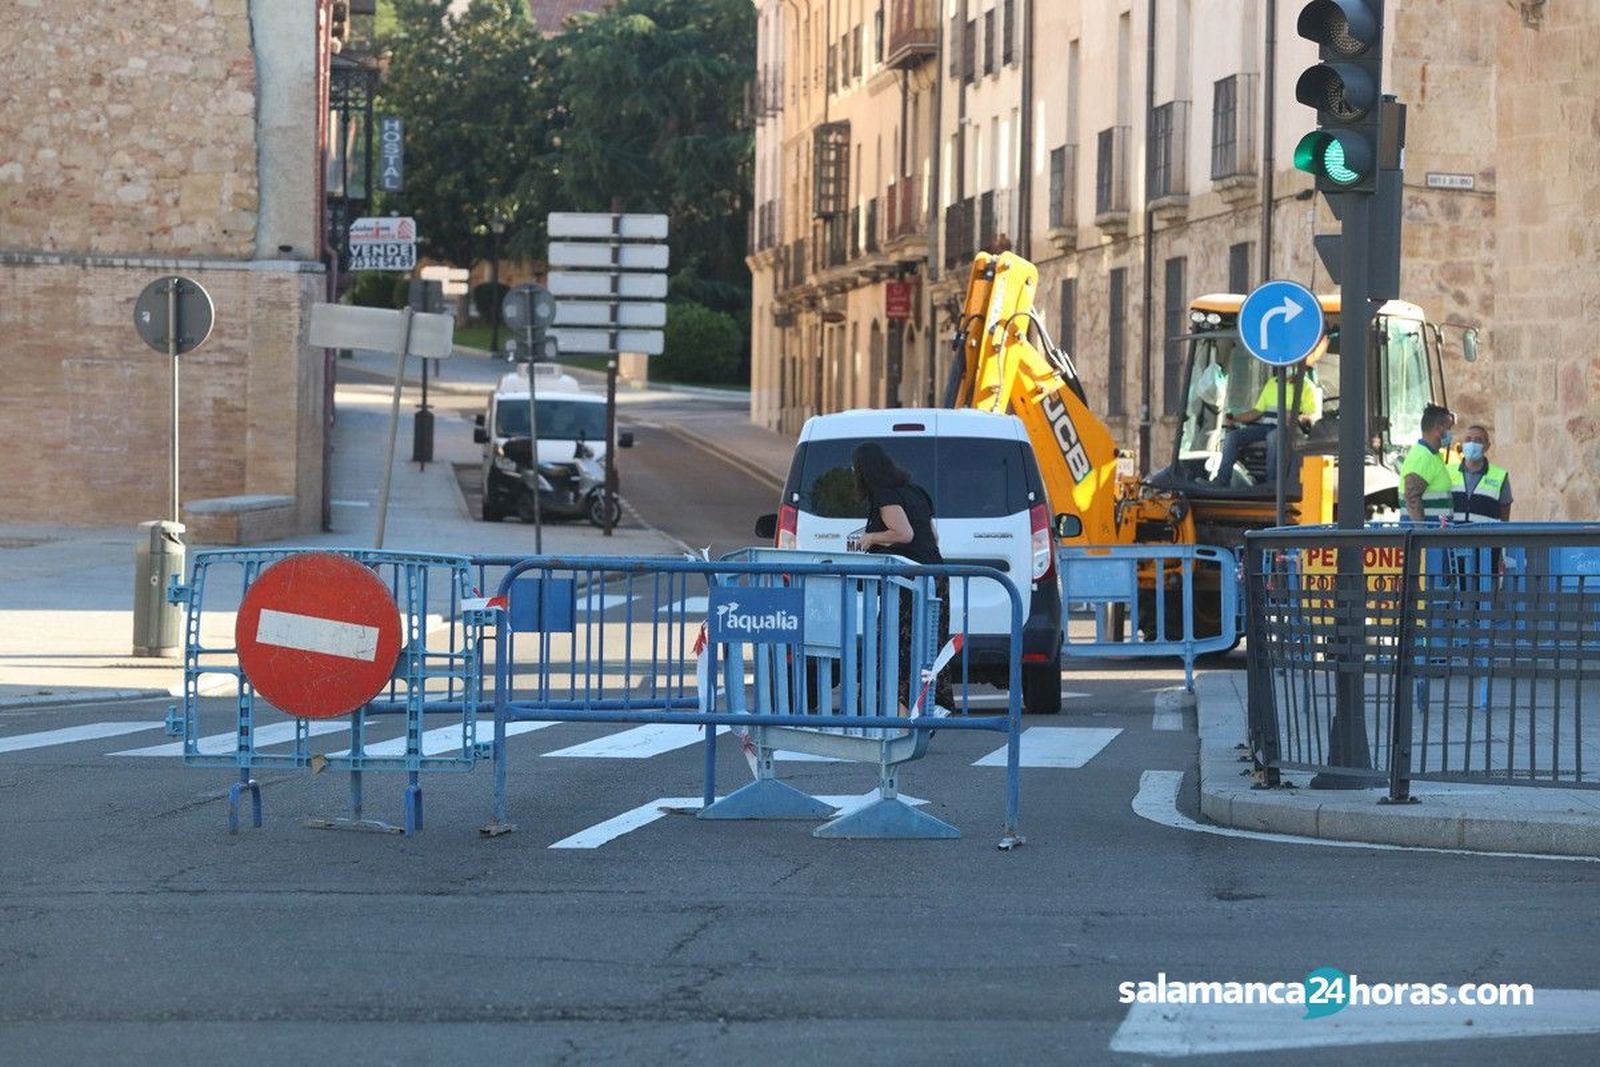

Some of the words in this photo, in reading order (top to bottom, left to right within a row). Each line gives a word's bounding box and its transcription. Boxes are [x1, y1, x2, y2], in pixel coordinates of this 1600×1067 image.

[383, 119, 400, 189] HOSTAL
[350, 244, 410, 256] VENDE
[1042, 395, 1091, 483] JCB
[726, 610, 799, 633] aqualia
